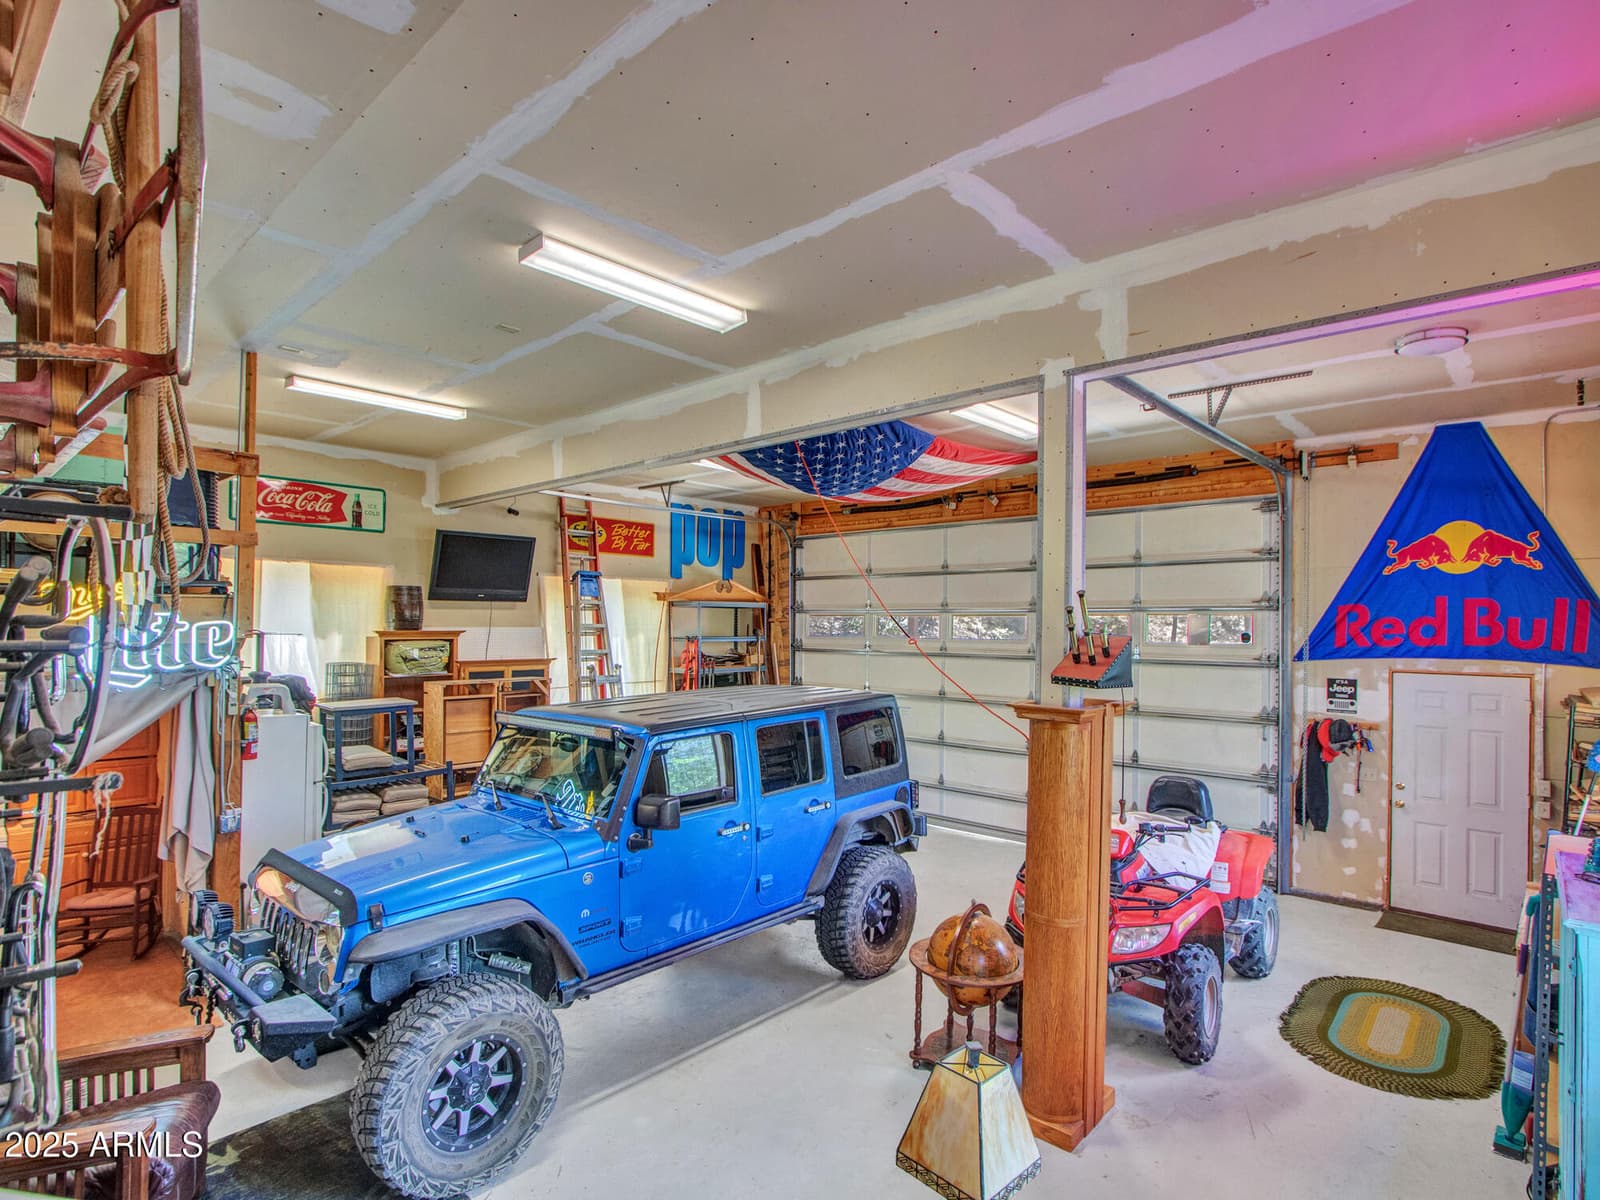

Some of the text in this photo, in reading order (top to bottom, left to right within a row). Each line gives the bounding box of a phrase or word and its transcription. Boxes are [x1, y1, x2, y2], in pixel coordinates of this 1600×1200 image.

[257, 487, 335, 513] Coca-Cola
[611, 523, 651, 539] Better
[670, 502, 746, 581] pop
[611, 535, 651, 551] By Far
[1334, 595, 1591, 654] Red Bull
[1329, 683, 1355, 695] Jeep
